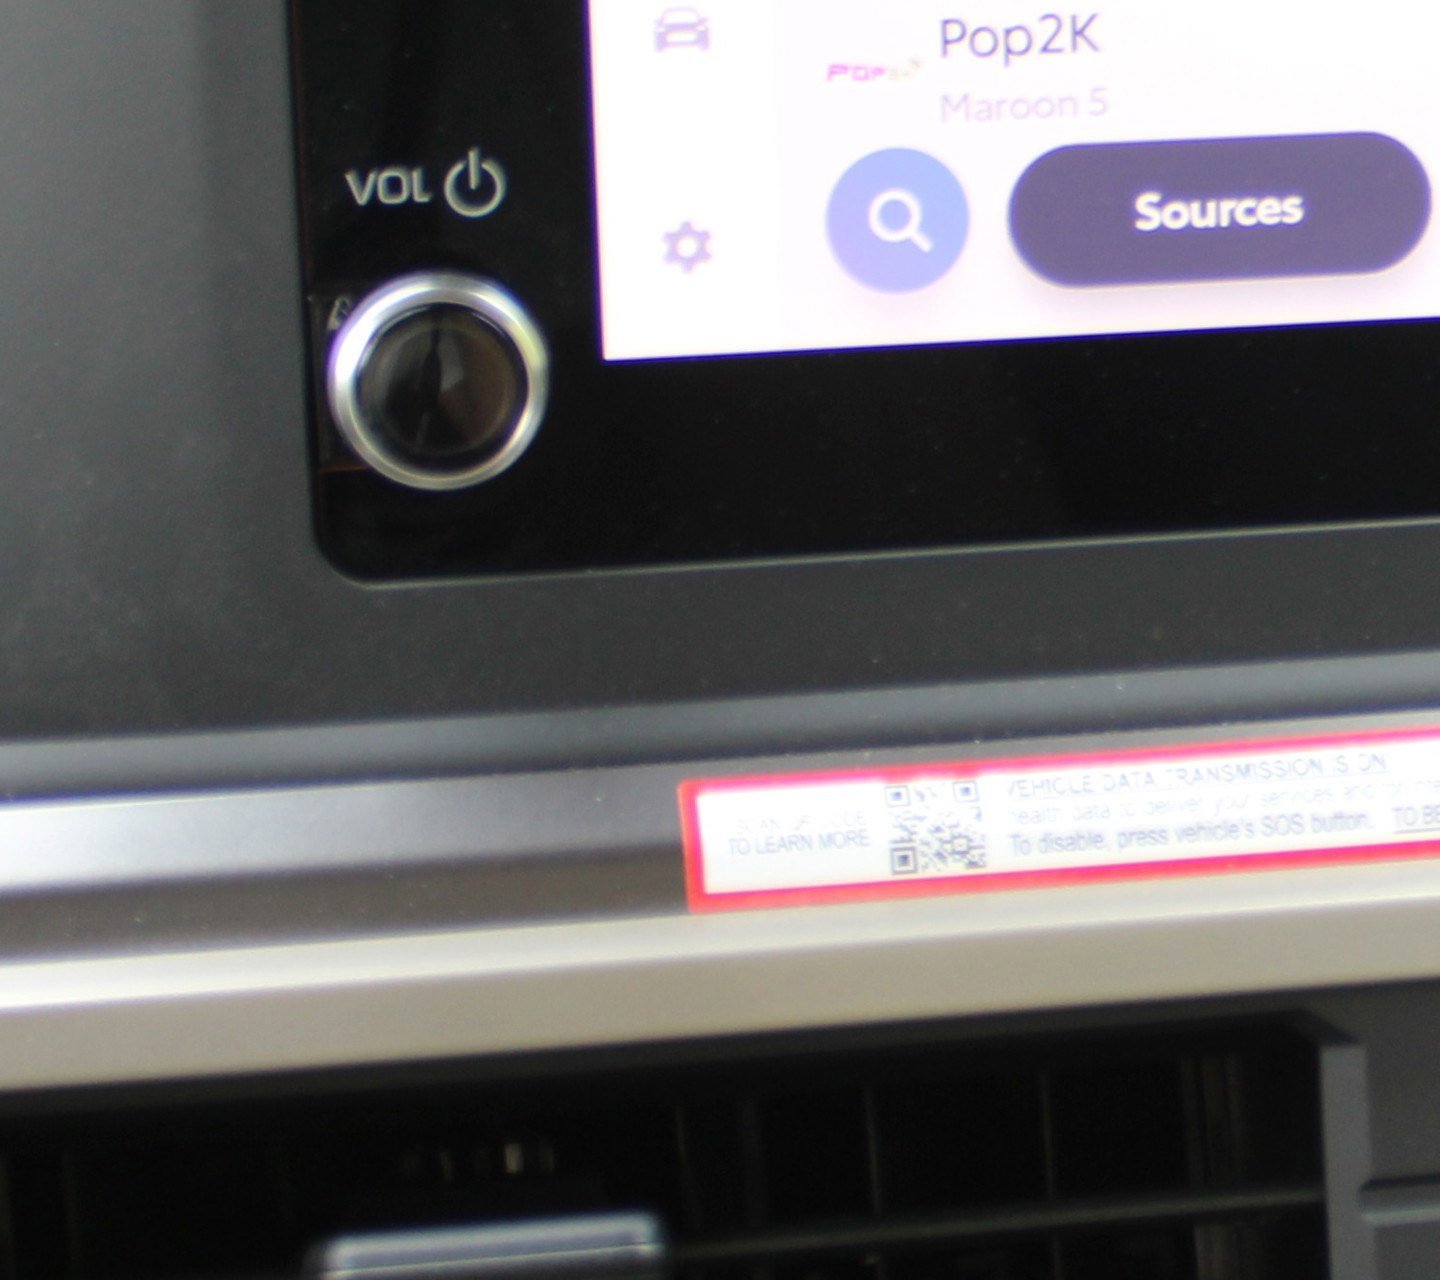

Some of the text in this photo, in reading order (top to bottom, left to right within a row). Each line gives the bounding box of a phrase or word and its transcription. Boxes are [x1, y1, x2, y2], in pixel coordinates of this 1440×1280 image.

[939, 12, 1100, 68] Pop2K
[939, 84, 1110, 124] Maroon 5
[344, 167, 431, 207] VOL
[1135, 190, 1304, 232] Sources
[1007, 773, 1094, 798] VEHICLE
[1166, 756, 1323, 788] TRANSMISSION
[728, 828, 870, 856] TO LEARN MORE
[1007, 832, 1032, 857] To
[1116, 827, 1170, 853] press
[1174, 818, 1256, 846] vehicle's
[1260, 812, 1306, 838] SOS
[1391, 805, 1418, 827] TO
